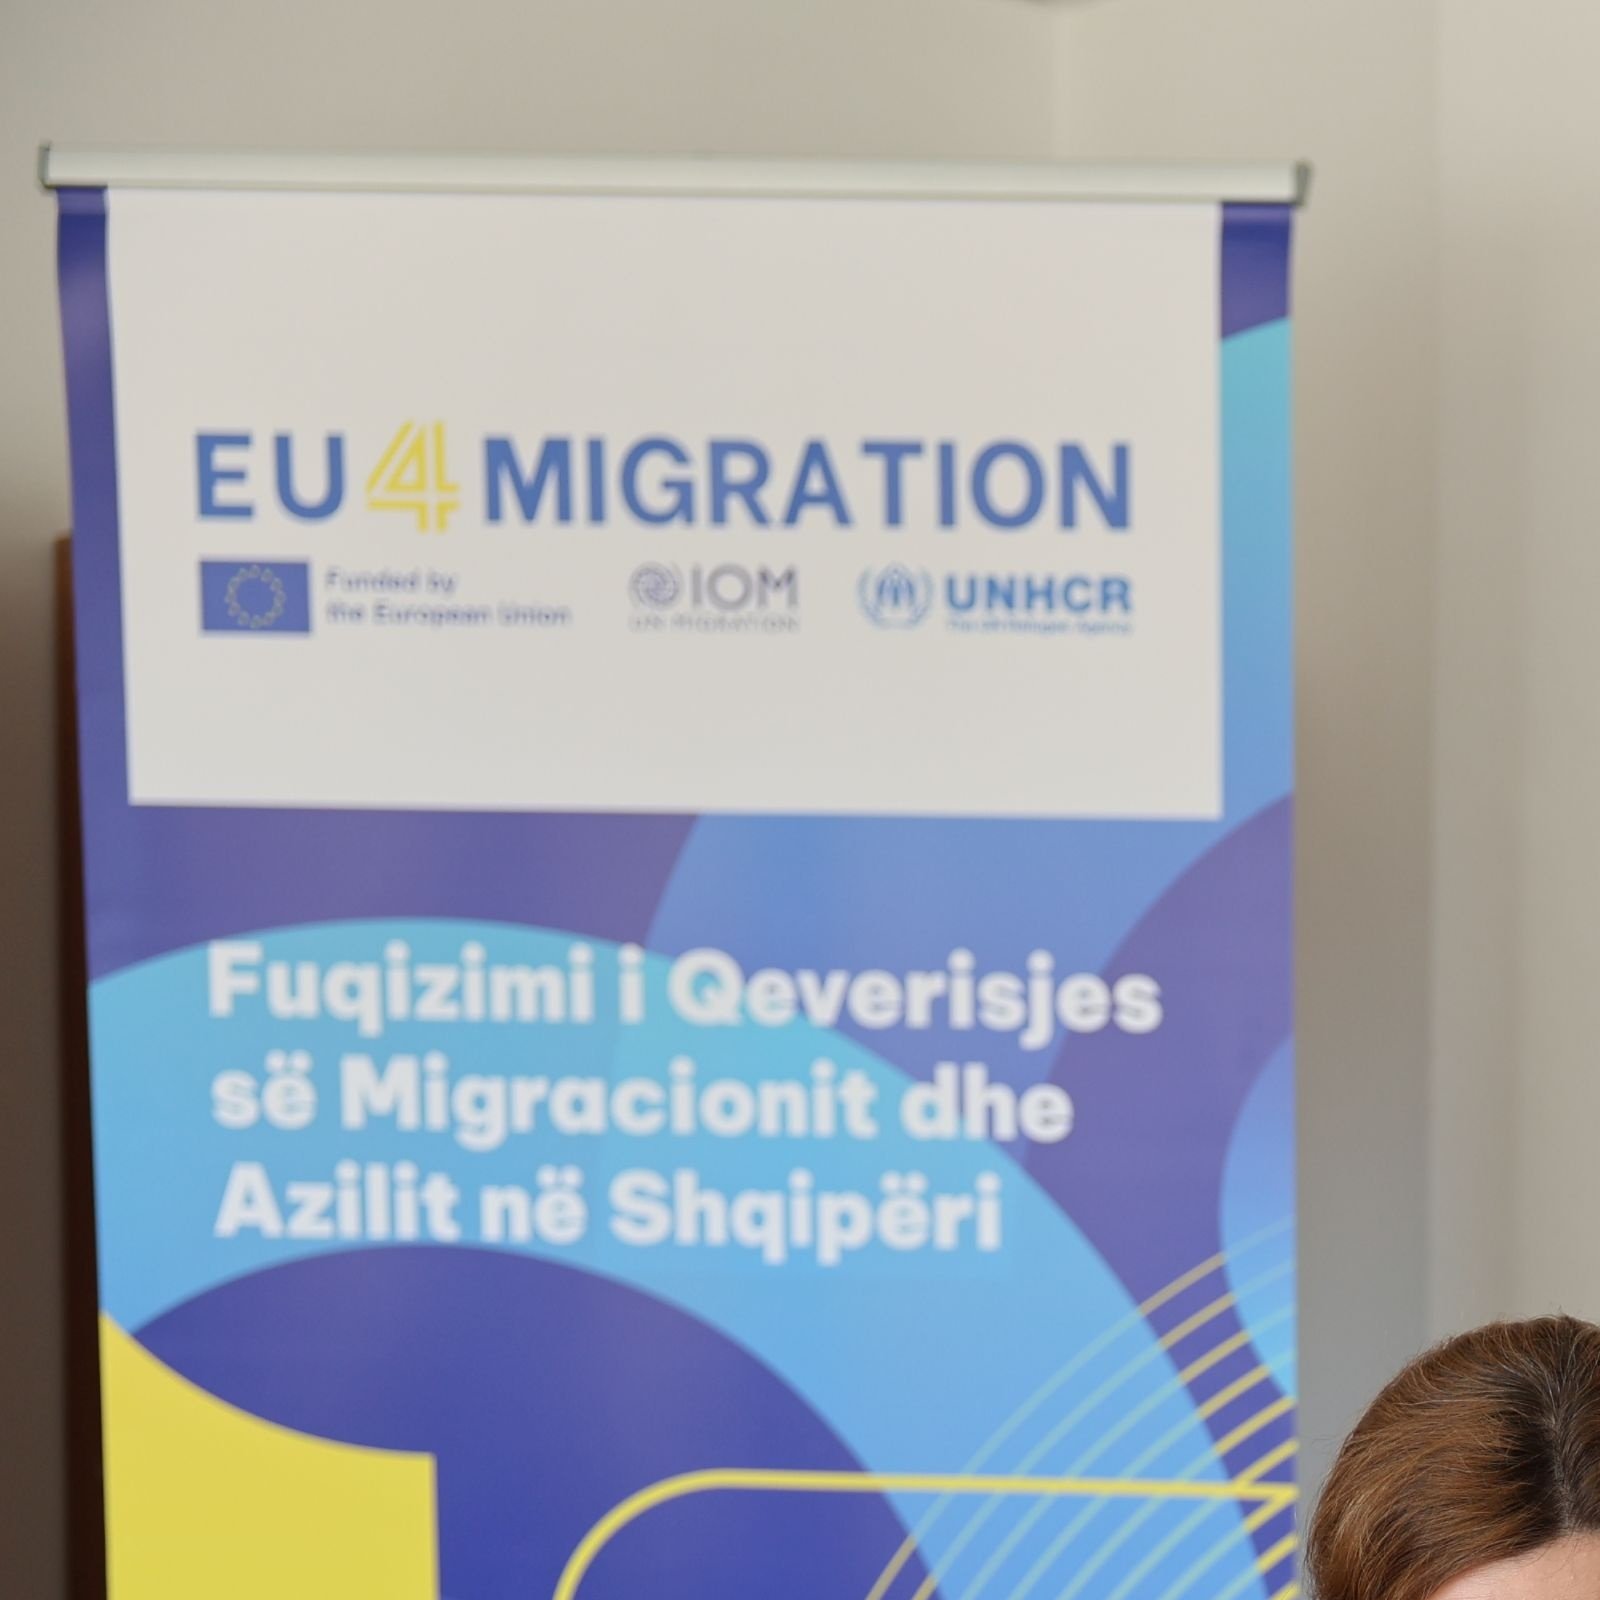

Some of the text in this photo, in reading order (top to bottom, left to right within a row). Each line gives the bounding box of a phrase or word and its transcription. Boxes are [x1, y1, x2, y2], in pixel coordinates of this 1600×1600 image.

[325, 568, 458, 597] Funded by
[689, 564, 798, 611] IOM
[944, 574, 1134, 613] UNHCR
[374, 604, 488, 631] European
[498, 605, 571, 627] Union
[206, 941, 1165, 1051] Fuqizimi i Qeverisjes
[210, 1050, 1076, 1151] së Migracionit dhe
[213, 1159, 1003, 1267] Azilit në Shqipëri
